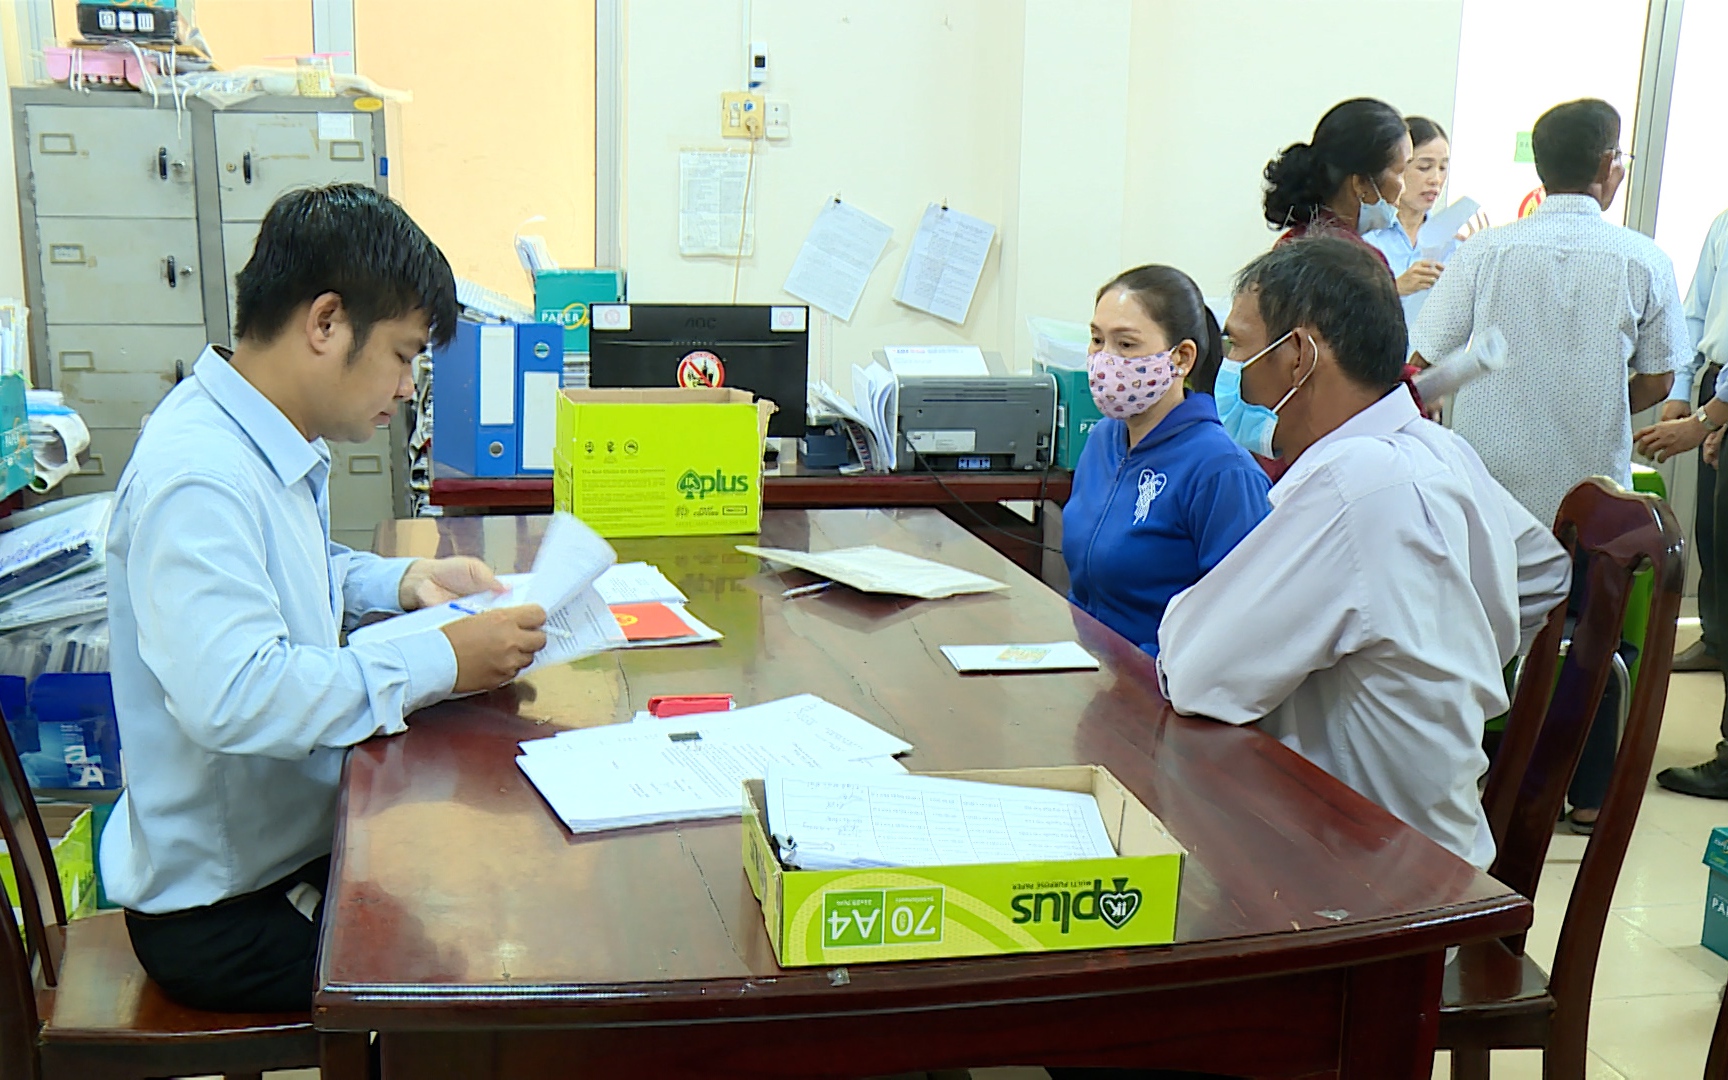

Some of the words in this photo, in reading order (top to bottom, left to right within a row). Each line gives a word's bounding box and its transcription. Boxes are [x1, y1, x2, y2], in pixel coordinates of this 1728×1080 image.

[541, 312, 580, 323] PAPER
[699, 469, 749, 500] plus
[891, 905, 936, 937] 70
[1011, 879, 1102, 934] plus
[1711, 896, 1728, 918] PA
[827, 907, 881, 940] A4
